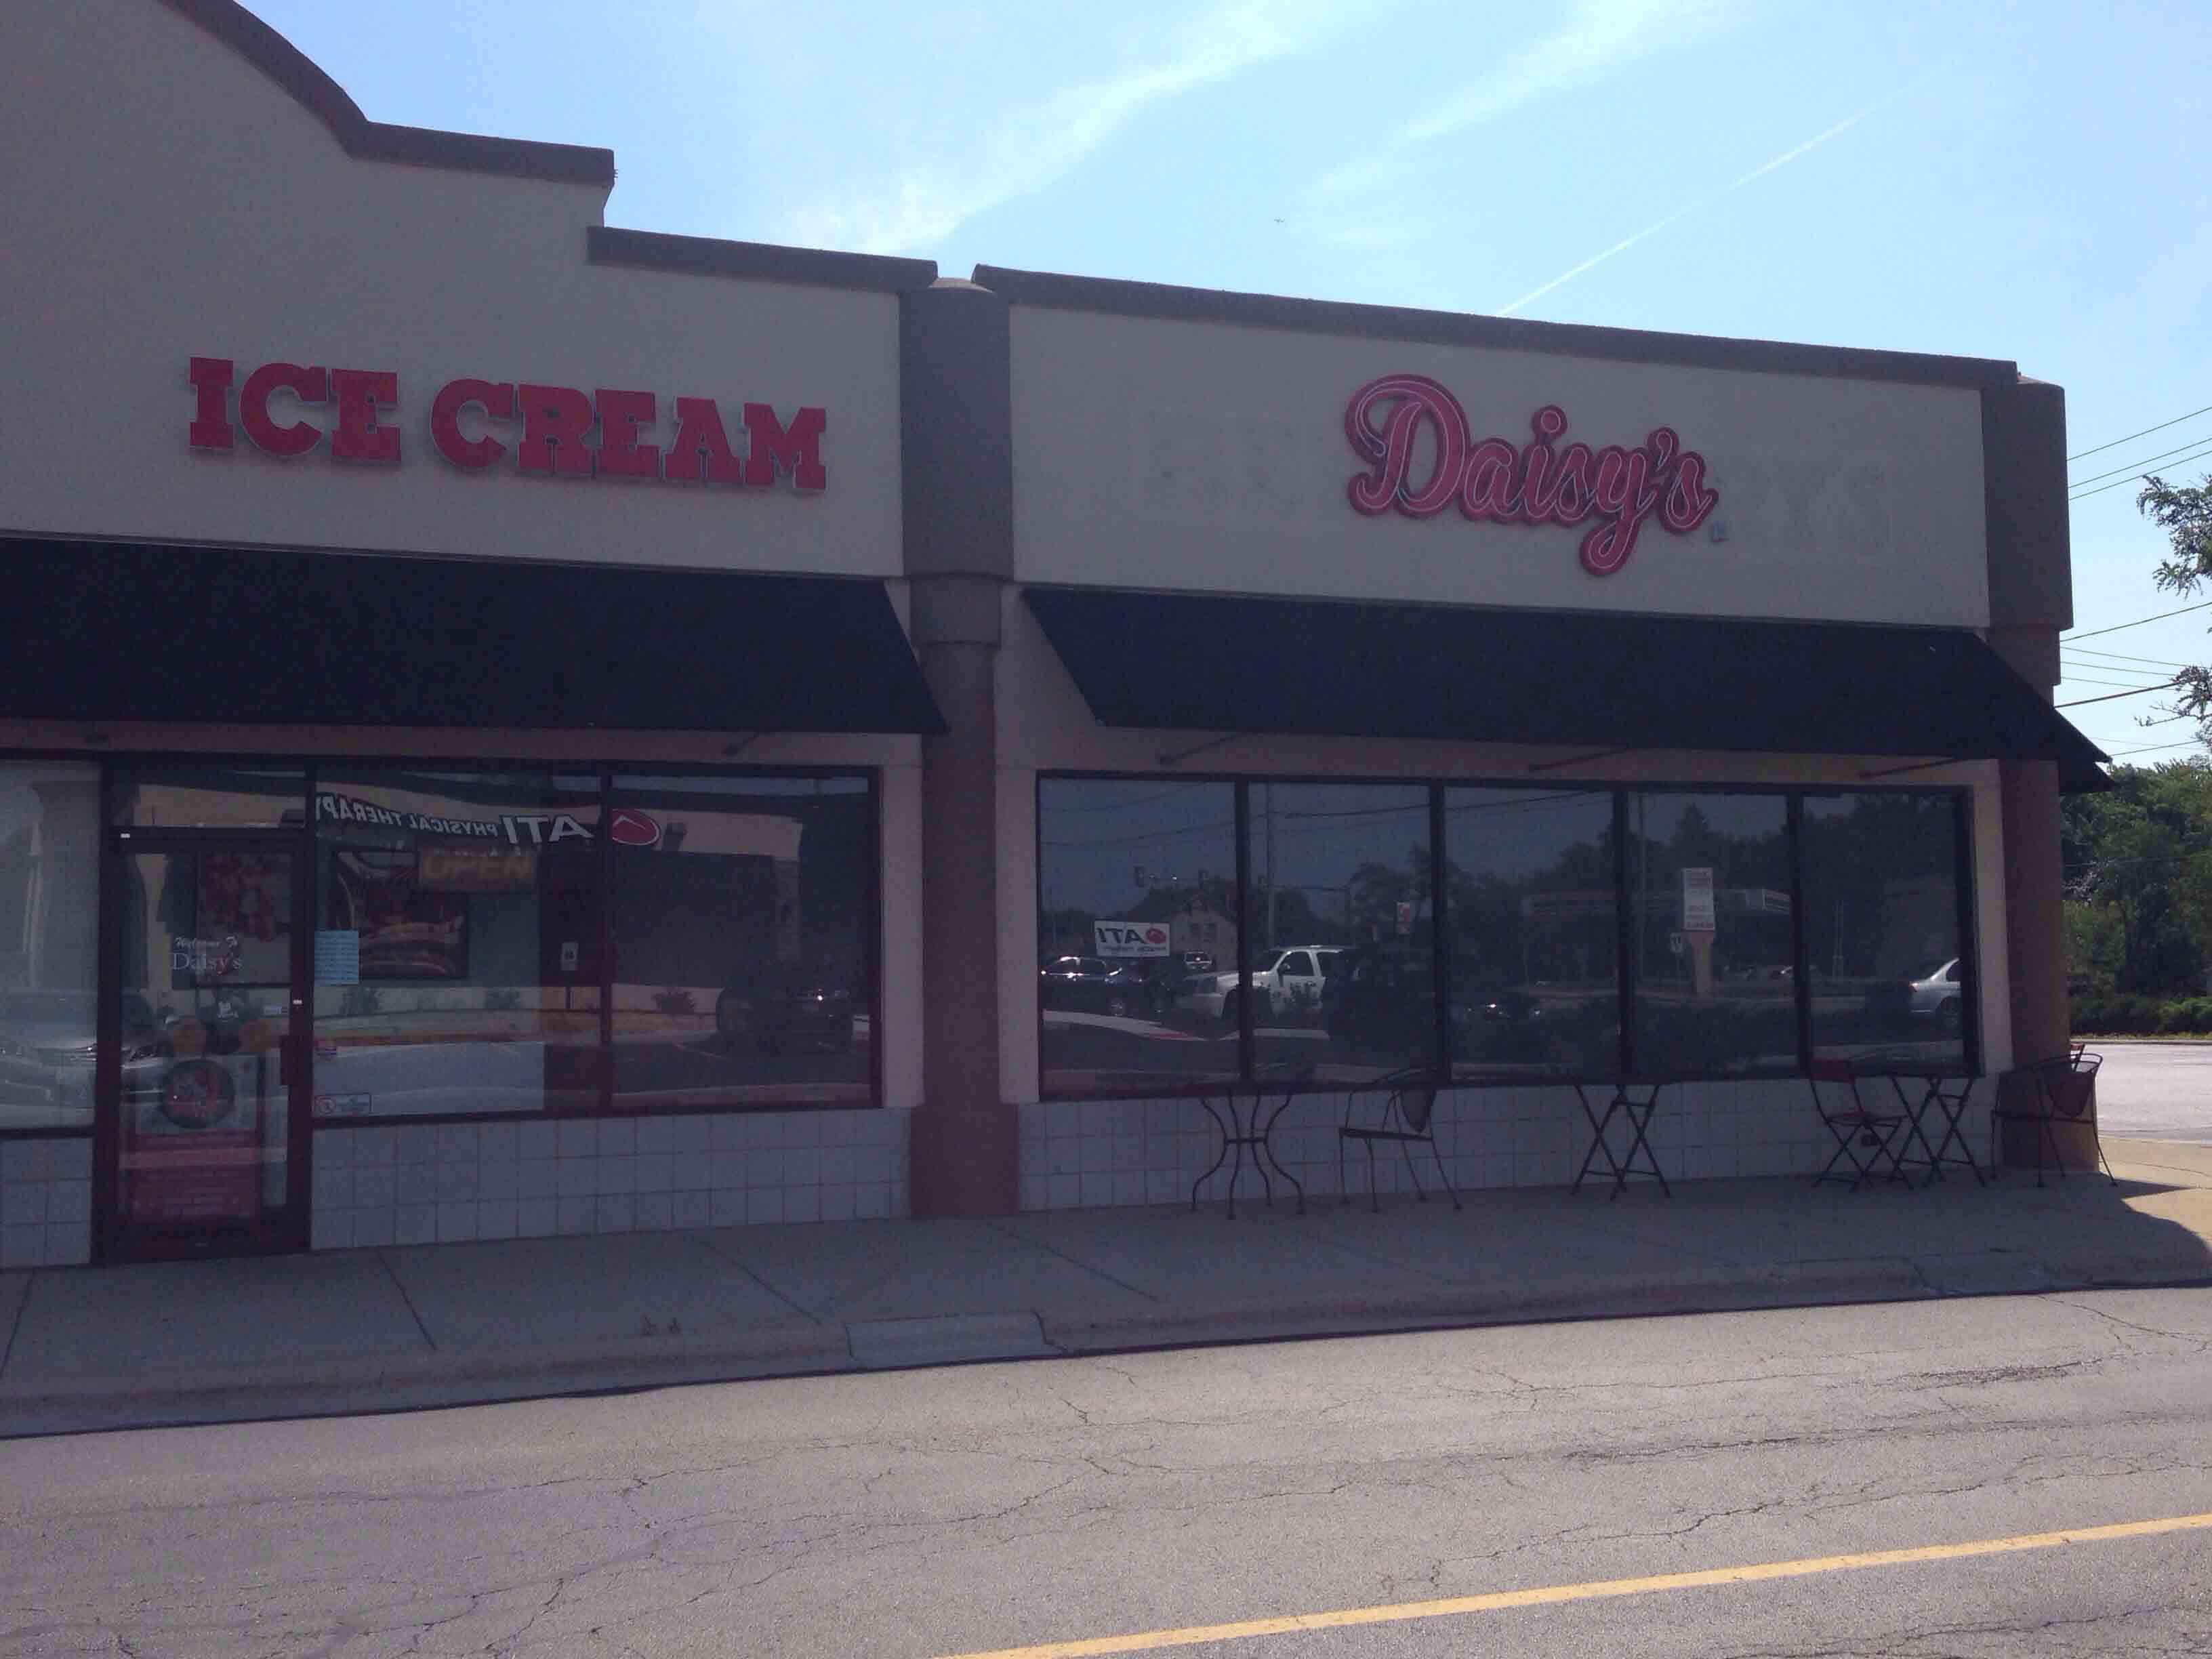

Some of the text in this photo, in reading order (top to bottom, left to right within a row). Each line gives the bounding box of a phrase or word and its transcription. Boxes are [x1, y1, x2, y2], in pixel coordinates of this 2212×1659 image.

[189, 356, 826, 490] ICE CREAM
[1345, 373, 1719, 576] Daisy's
